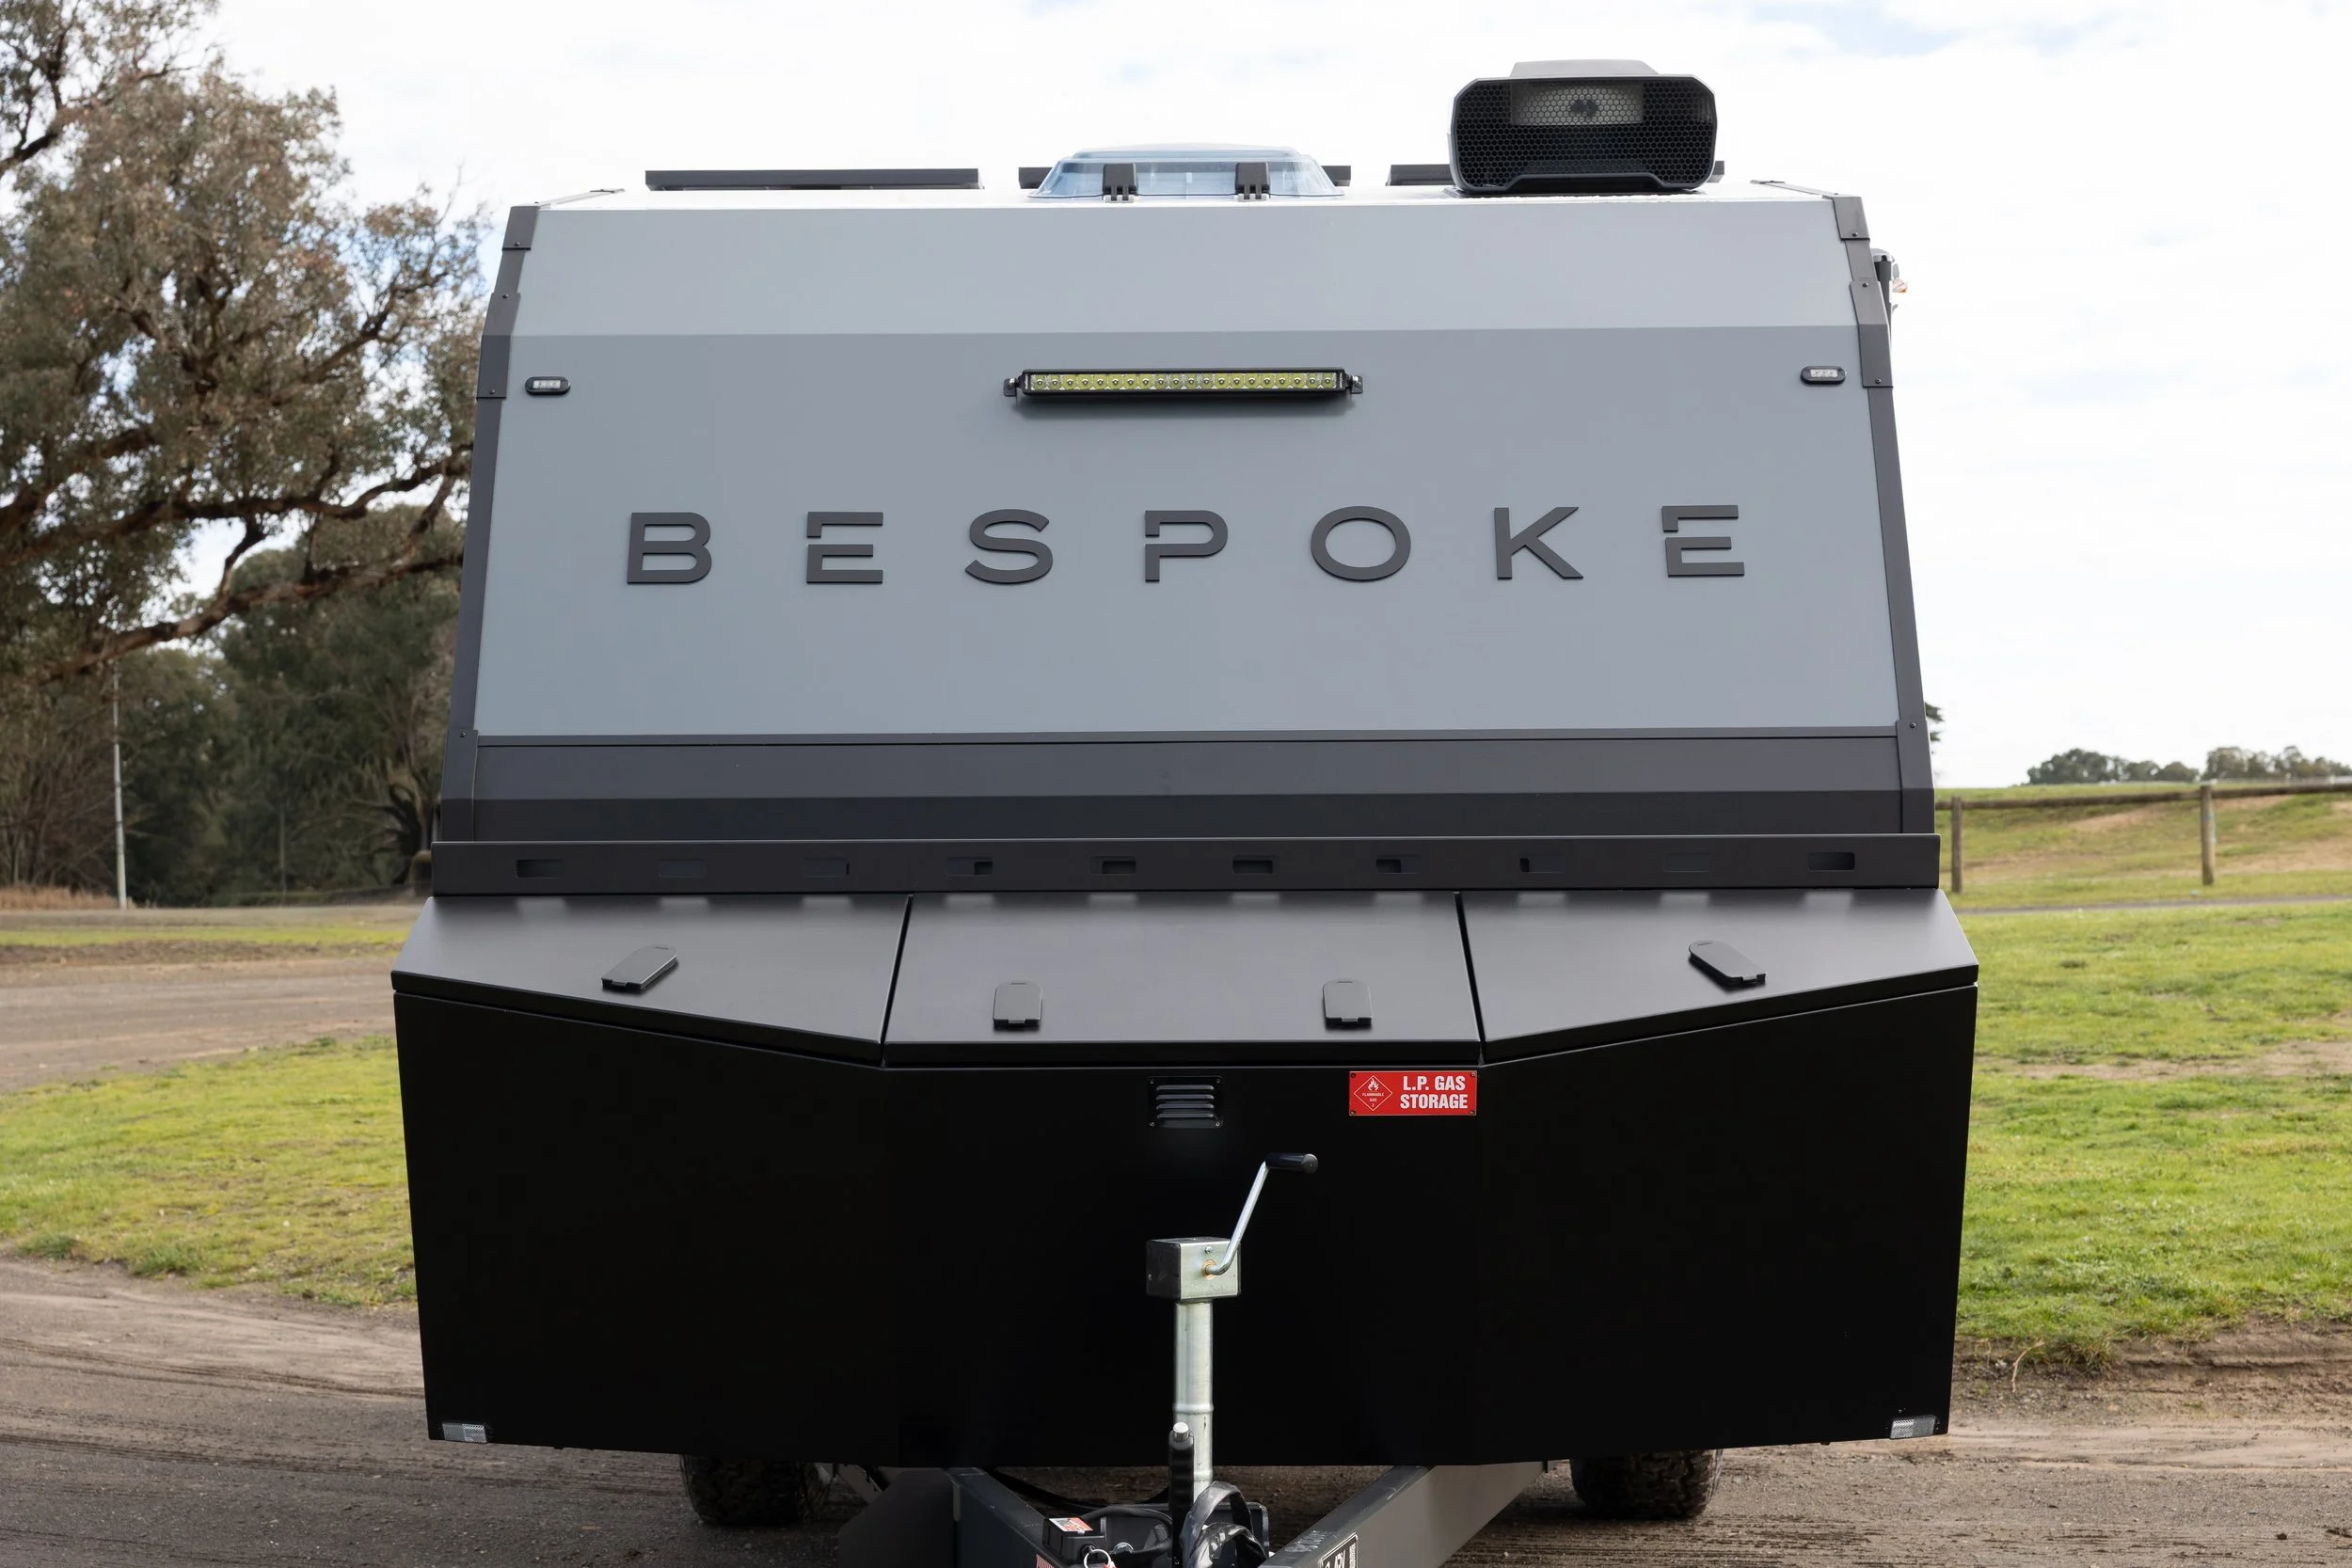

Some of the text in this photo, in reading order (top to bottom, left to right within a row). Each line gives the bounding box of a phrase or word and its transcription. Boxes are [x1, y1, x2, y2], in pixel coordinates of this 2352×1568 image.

[627, 505, 1745, 585] BESPOKE
[1403, 1075, 1466, 1091] L.P. GAS
[1400, 1094, 1469, 1110] STORAGE
